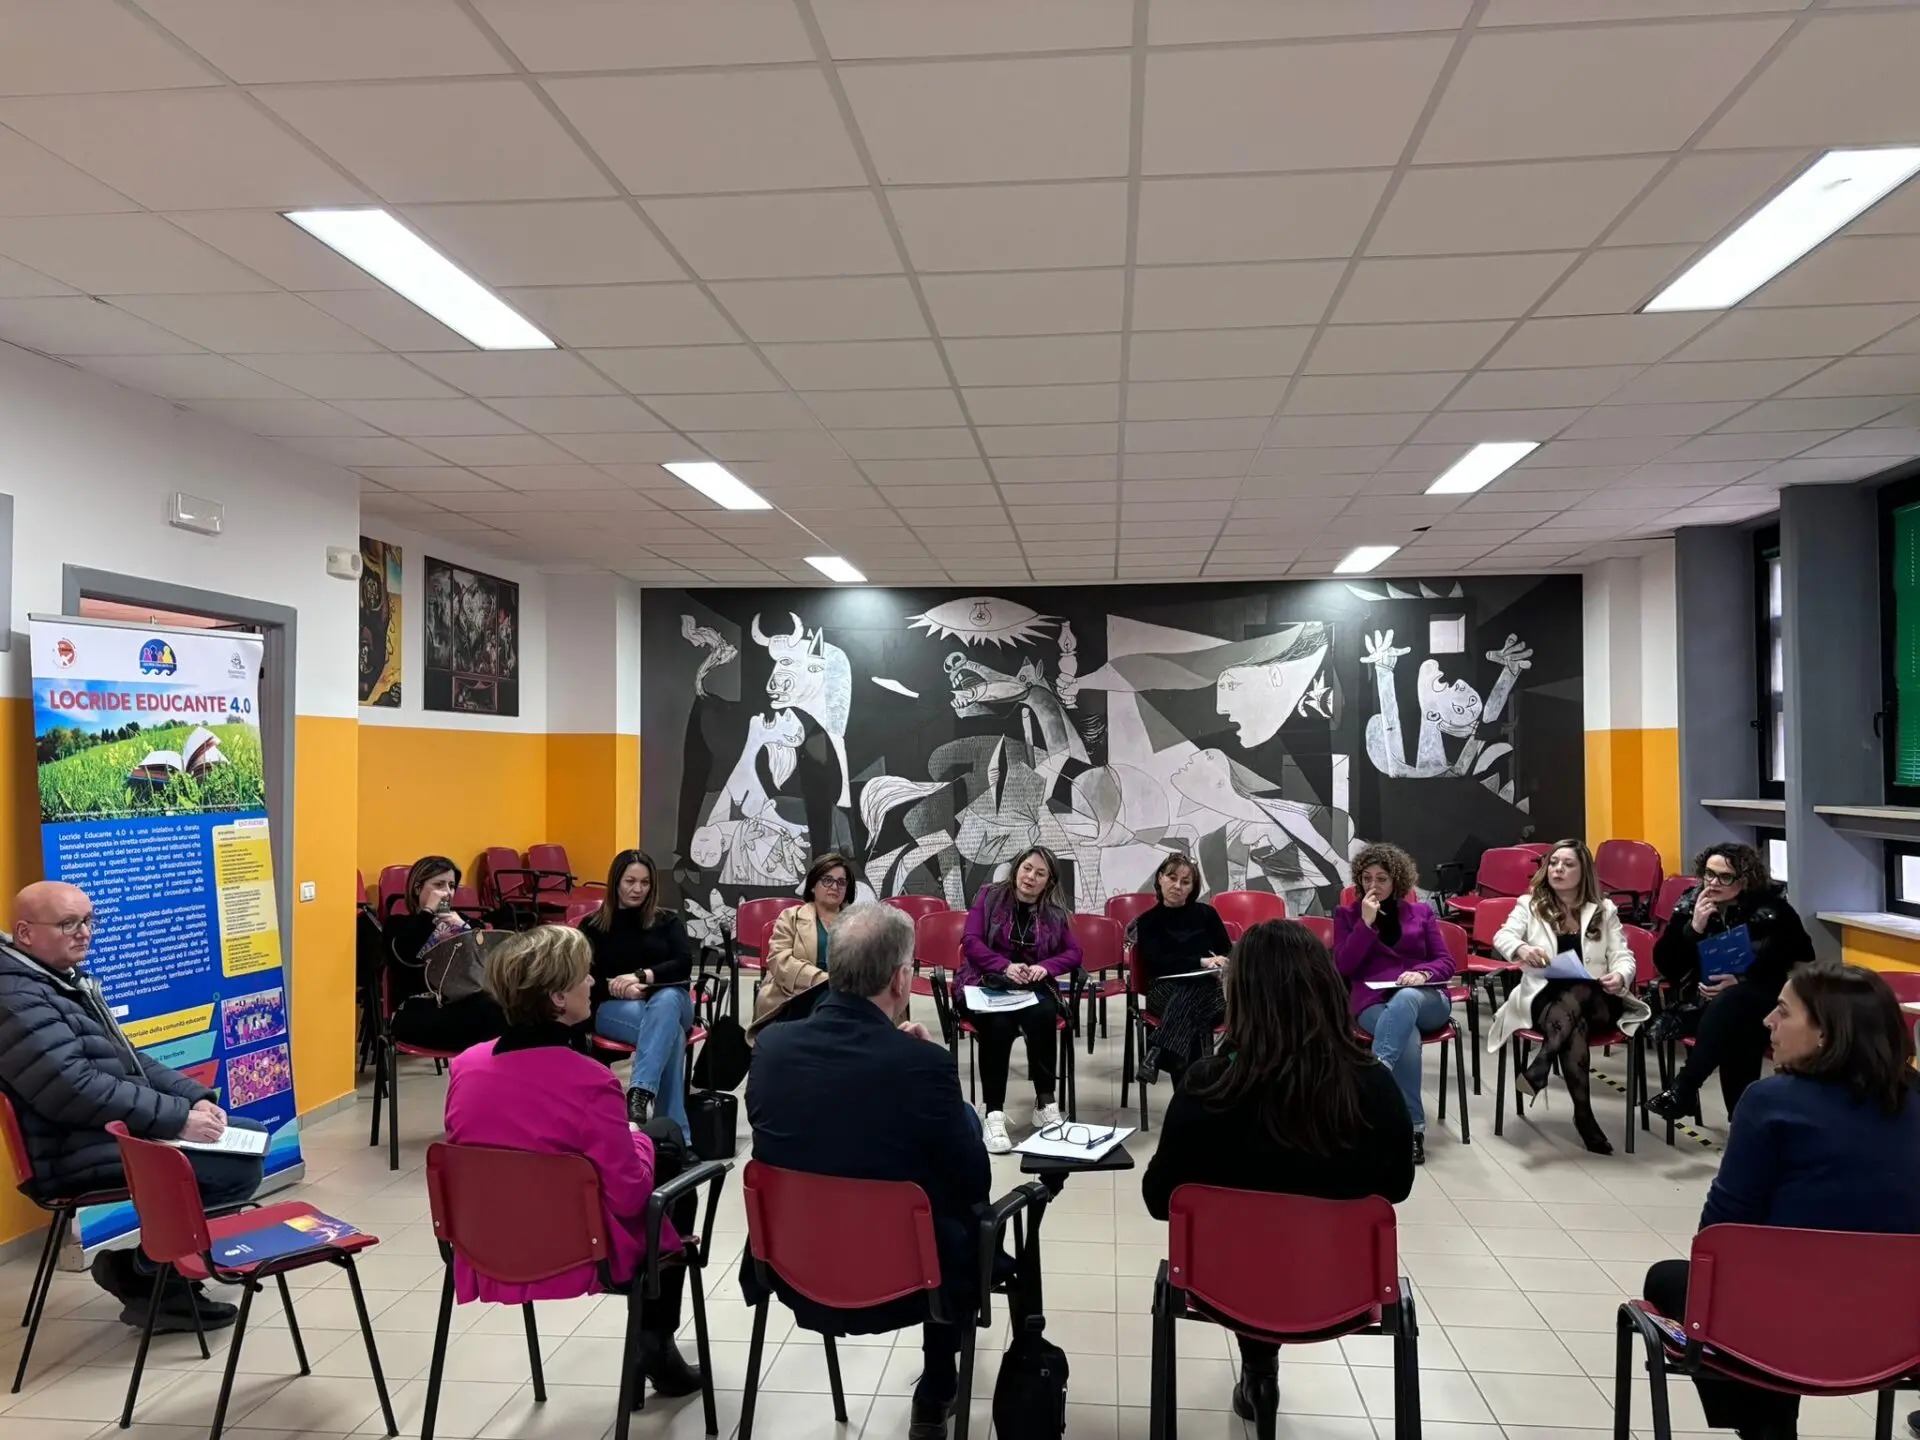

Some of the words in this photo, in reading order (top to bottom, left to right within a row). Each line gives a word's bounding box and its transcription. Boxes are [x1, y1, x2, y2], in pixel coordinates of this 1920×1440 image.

[50, 689, 131, 711] LOCRIDE
[135, 692, 227, 713] EDUCANTE
[229, 697, 251, 714] 4.0
[59, 832, 81, 841] Locride
[84, 831, 112, 839] Educante
[60, 842, 85, 851] biennale
[86, 840, 112, 850] proposta
[120, 838, 138, 846] stretta
[139, 835, 171, 844] condivisione
[73, 851, 80, 859] di
[80, 850, 102, 859] scuole,
[102, 849, 115, 857] enti
[115, 848, 125, 856] del
[126, 847, 141, 855] terzo
[142, 845, 161, 853] settore
[192, 841, 201, 849] che
[61, 861, 97, 871] collaborano
[109, 857, 128, 867] questi
[130, 856, 143, 864] temi
[145, 854, 153, 862] da
[155, 853, 171, 861] alcuni
[186, 850, 195, 858] che
[61, 871, 89, 881] propone
[92, 869, 99, 877] di
[103, 865, 140, 877] promuovere
[144, 864, 155, 872] una
[159, 858, 202, 870] infrastrutturazione
[93, 876, 126, 887] territoriale,
[128, 872, 161, 882] immaginata
[162, 870, 176, 879] come
[98, 888, 105, 896] di
[107, 886, 121, 895] tutte
[124, 885, 130, 893] le
[132, 883, 152, 892] risorse
[154, 881, 164, 890] per
[171, 877, 193, 887] contrasto
[195, 876, 204, 884] alla
[125, 892, 149, 902] esistenti
[152, 890, 162, 898] nel
[163, 887, 190, 897] circondario
[192, 884, 204, 894] della
[94, 905, 121, 915] Calabria.
[111, 914, 123, 923] che
[124, 912, 136, 921] sarà
[136, 909, 160, 919] regolato
[161, 907, 173, 916] dalla
[174, 903, 206, 914] sottoscrizione
[94, 933, 121, 945] modalità
[125, 931, 132, 940] di
[136, 928, 167, 938] attivazione
[169, 924, 182, 933] della
[185, 920, 208, 930] comunità
[107, 922, 137, 933] educativo
[138, 920, 145, 928] di
[175, 914, 184, 922] che
[93, 955, 106, 965] cioè
[109, 953, 116, 961] di
[118, 949, 150, 961] sviluppare
[151, 946, 158, 954] le
[160, 941, 188, 954] potenzialità
[190, 939, 199, 947] dei
[200, 938, 209, 947] più
[99, 944, 118, 953] intesa
[118, 942, 136, 950] come
[136, 939, 148, 948] una
[95, 962, 126, 973] mitigando
[126, 960, 133, 968] le
[134, 956, 159, 967] disparità
[159, 952, 176, 962] sociali
[176, 951, 183, 959] ed
[103, 971, 132, 982] formativo
[134, 965, 163, 976] attraverso
[176, 957, 202, 968] strutturato
[203, 955, 210, 963] ed
[115, 979, 138, 990] sistema
[140, 973, 168, 985] educativo
[168, 968, 194, 979] territoriale
[115, 986, 151, 1000] scuola/extra
[152, 982, 170, 992] scuola.
[149, 1025, 163, 1035] della
[163, 1019, 186, 1031] comunità
[185, 1015, 207, 1026] educante
